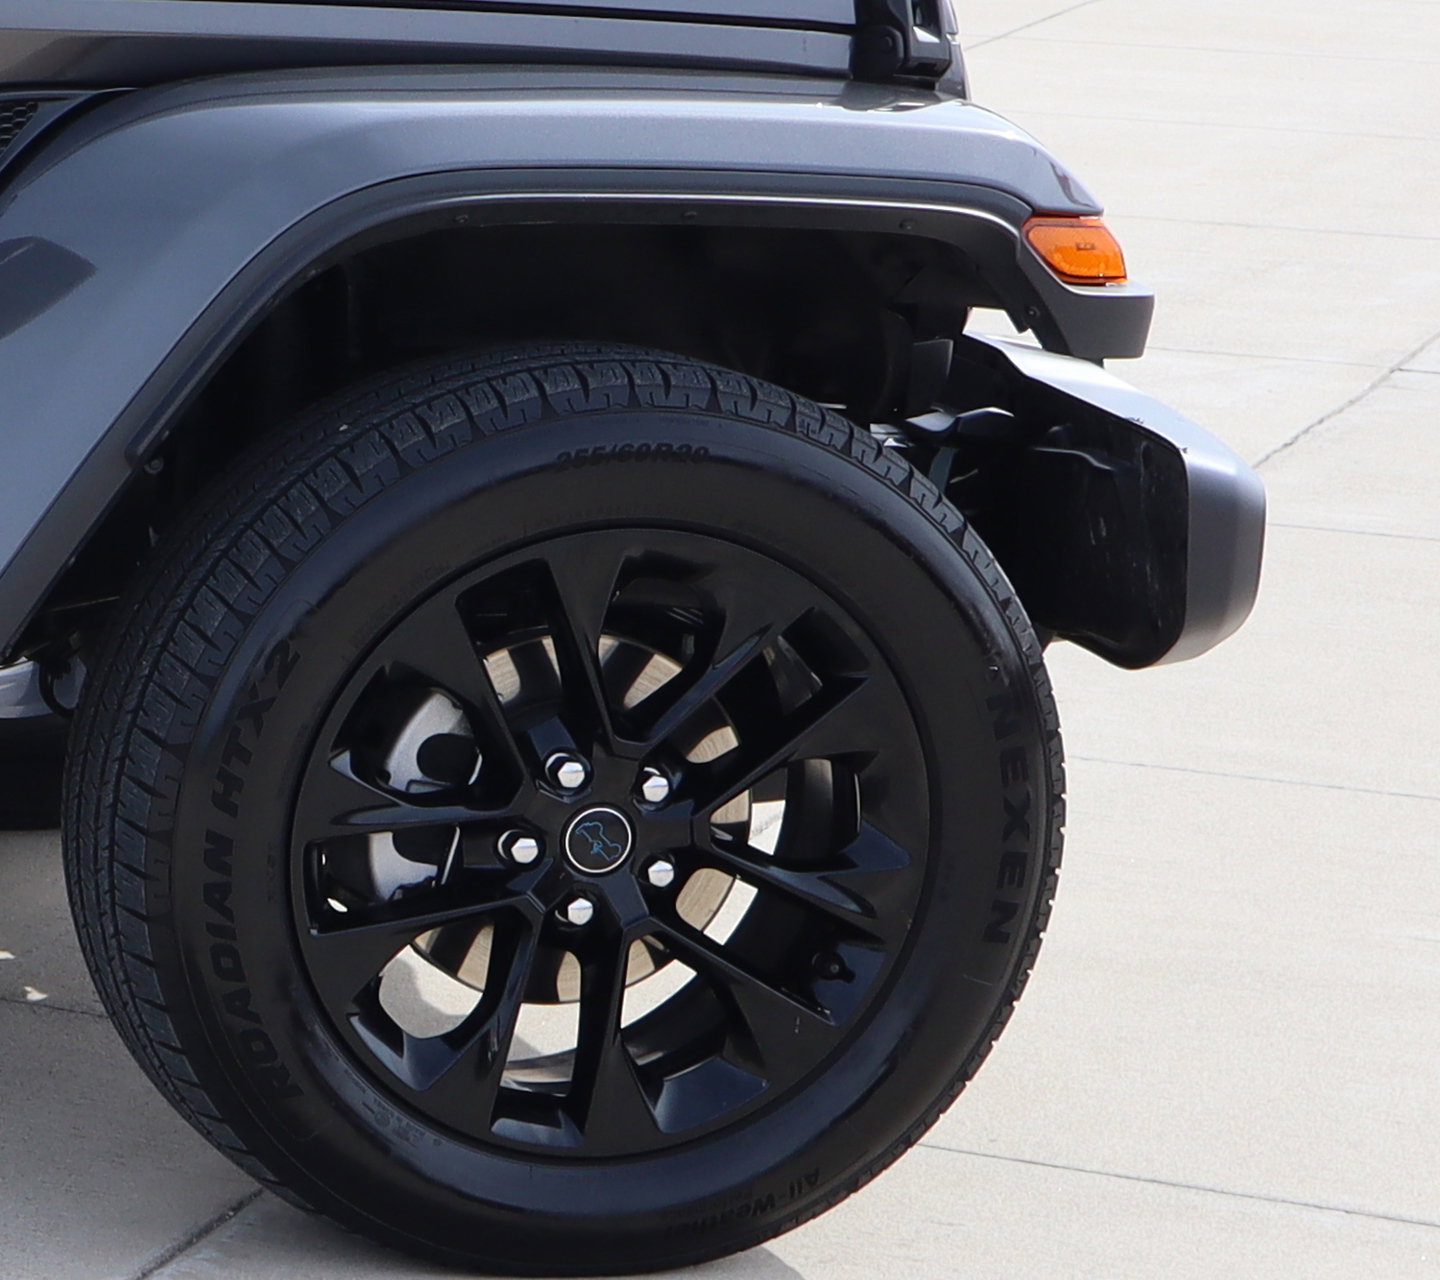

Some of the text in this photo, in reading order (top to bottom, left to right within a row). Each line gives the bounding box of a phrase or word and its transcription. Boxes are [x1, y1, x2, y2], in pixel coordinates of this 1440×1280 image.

[202, 637, 305, 1102] ROADIAN HTX2
[981, 693, 1031, 945] NEXEN
